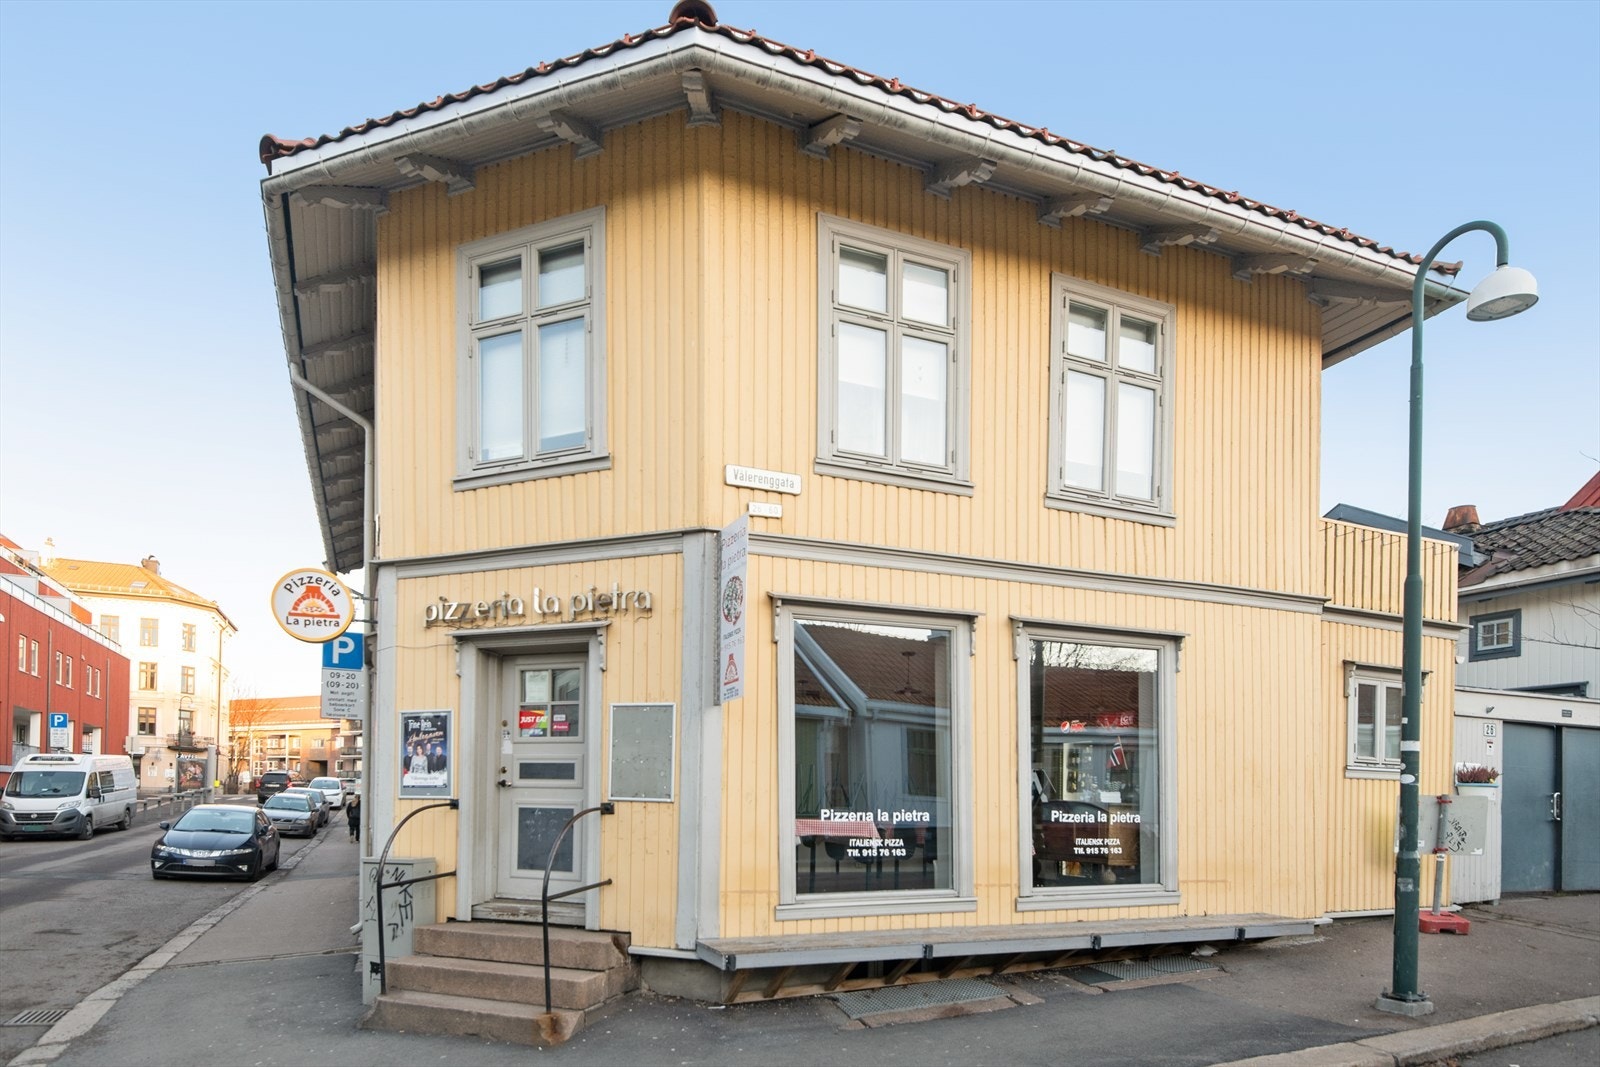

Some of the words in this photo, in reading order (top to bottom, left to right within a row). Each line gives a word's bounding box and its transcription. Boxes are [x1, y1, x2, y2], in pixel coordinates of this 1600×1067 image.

[284, 576, 341, 597] Pizzeria
[424, 591, 524, 625] pizzeria
[534, 587, 562, 614] la
[569, 582, 652, 623] pietra
[286, 616, 300, 625] La
[304, 617, 340, 628] pietra
[332, 636, 355, 664] P
[54, 714, 64, 727] P
[520, 715, 536, 723] JUST
[820, 808, 874, 822] Pizzeria
[877, 808, 889, 822] la
[893, 809, 930, 824] pietra
[1051, 809, 1095, 823] Pizzeria
[1097, 810, 1107, 822] la
[1110, 811, 1141, 825] pietra
[849, 838, 883, 847] ITALIENSK
[884, 838, 904, 847] PIZZA
[1075, 838, 1103, 846] ITALIENSK
[1104, 838, 1121, 846] PIZZA
[862, 848, 877, 857] 915
[879, 848, 890, 857] 76
[892, 848, 906, 857] 163
[1086, 847, 1099, 855] 915
[1100, 847, 1109, 855] 76
[1110, 847, 1122, 855] 163
